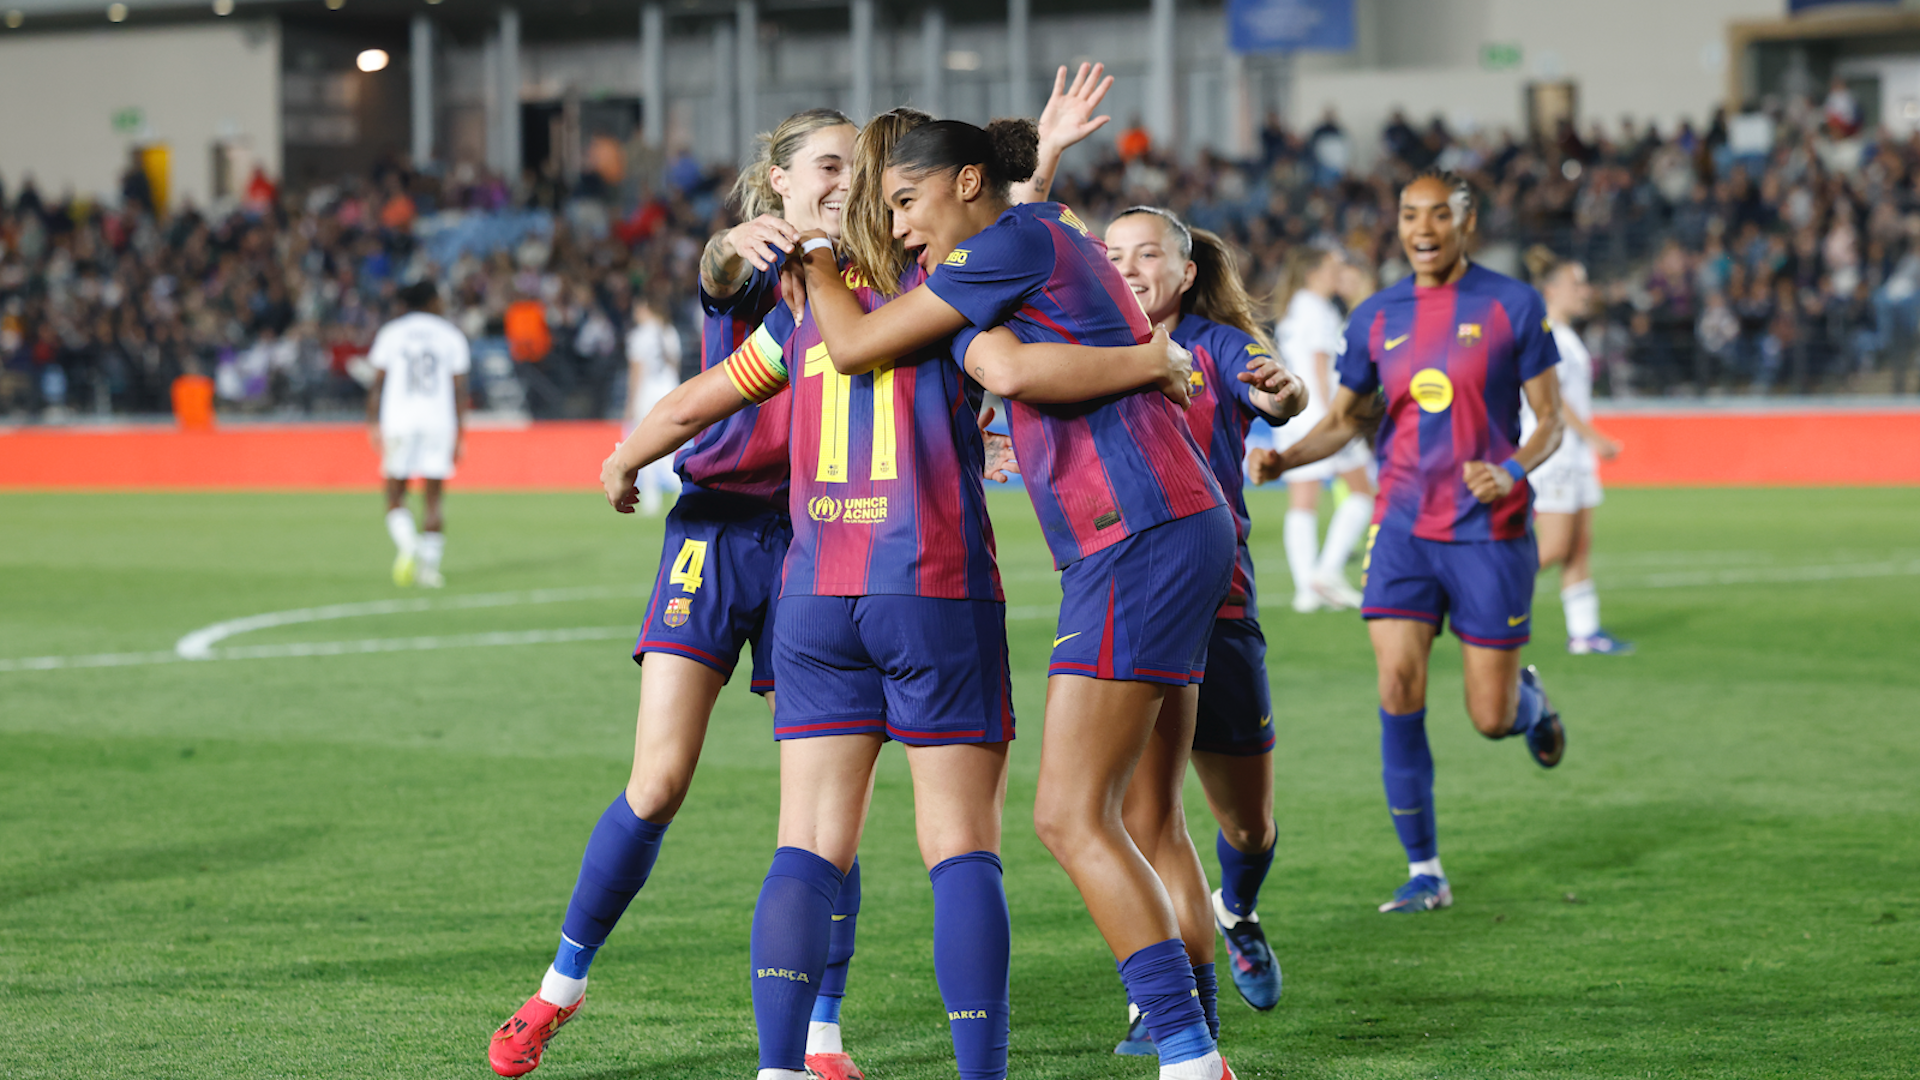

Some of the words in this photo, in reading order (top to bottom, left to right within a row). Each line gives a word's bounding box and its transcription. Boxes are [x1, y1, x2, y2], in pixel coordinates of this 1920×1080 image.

[803, 340, 898, 483] 11
[844, 497, 888, 509] UNHCR
[843, 507, 888, 519] ACNUR
[669, 538, 708, 594] 4
[757, 967, 810, 984] BARÇA
